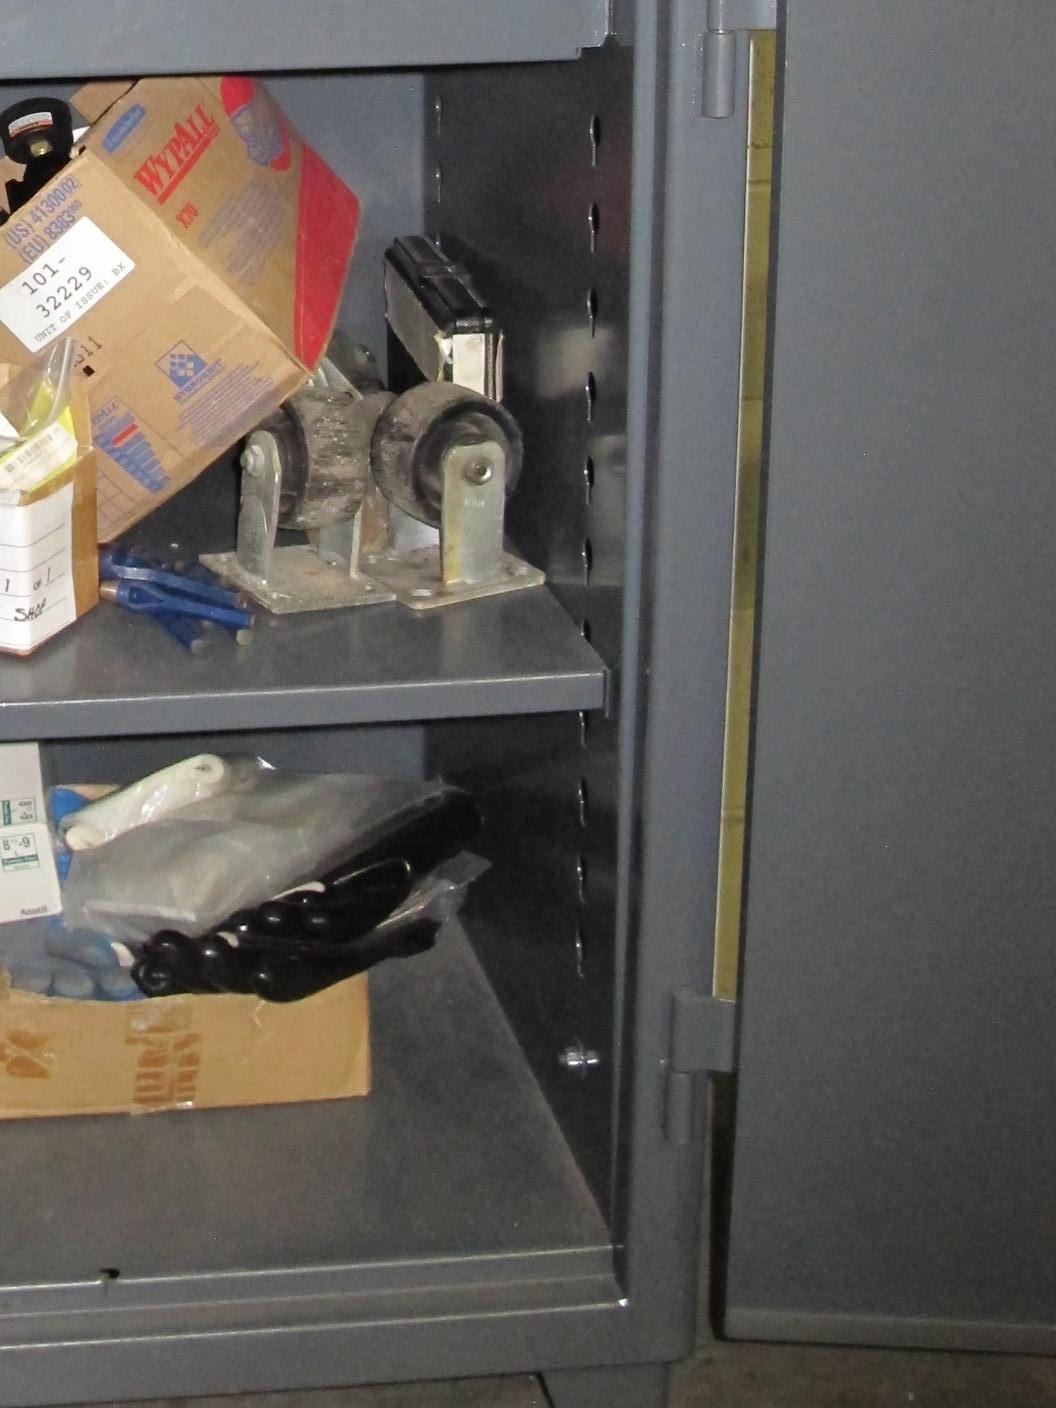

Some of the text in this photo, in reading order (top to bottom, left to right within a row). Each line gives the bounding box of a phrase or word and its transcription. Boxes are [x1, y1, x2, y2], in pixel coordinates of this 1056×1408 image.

[22, 256, 66, 296] 101-
[35, 265, 93, 318] 32229
[34, 323, 58, 343] UNIT
[59, 310, 72, 324] OF
[111, 262, 127, 277] BX
[14, 597, 48, 622] SHOP
